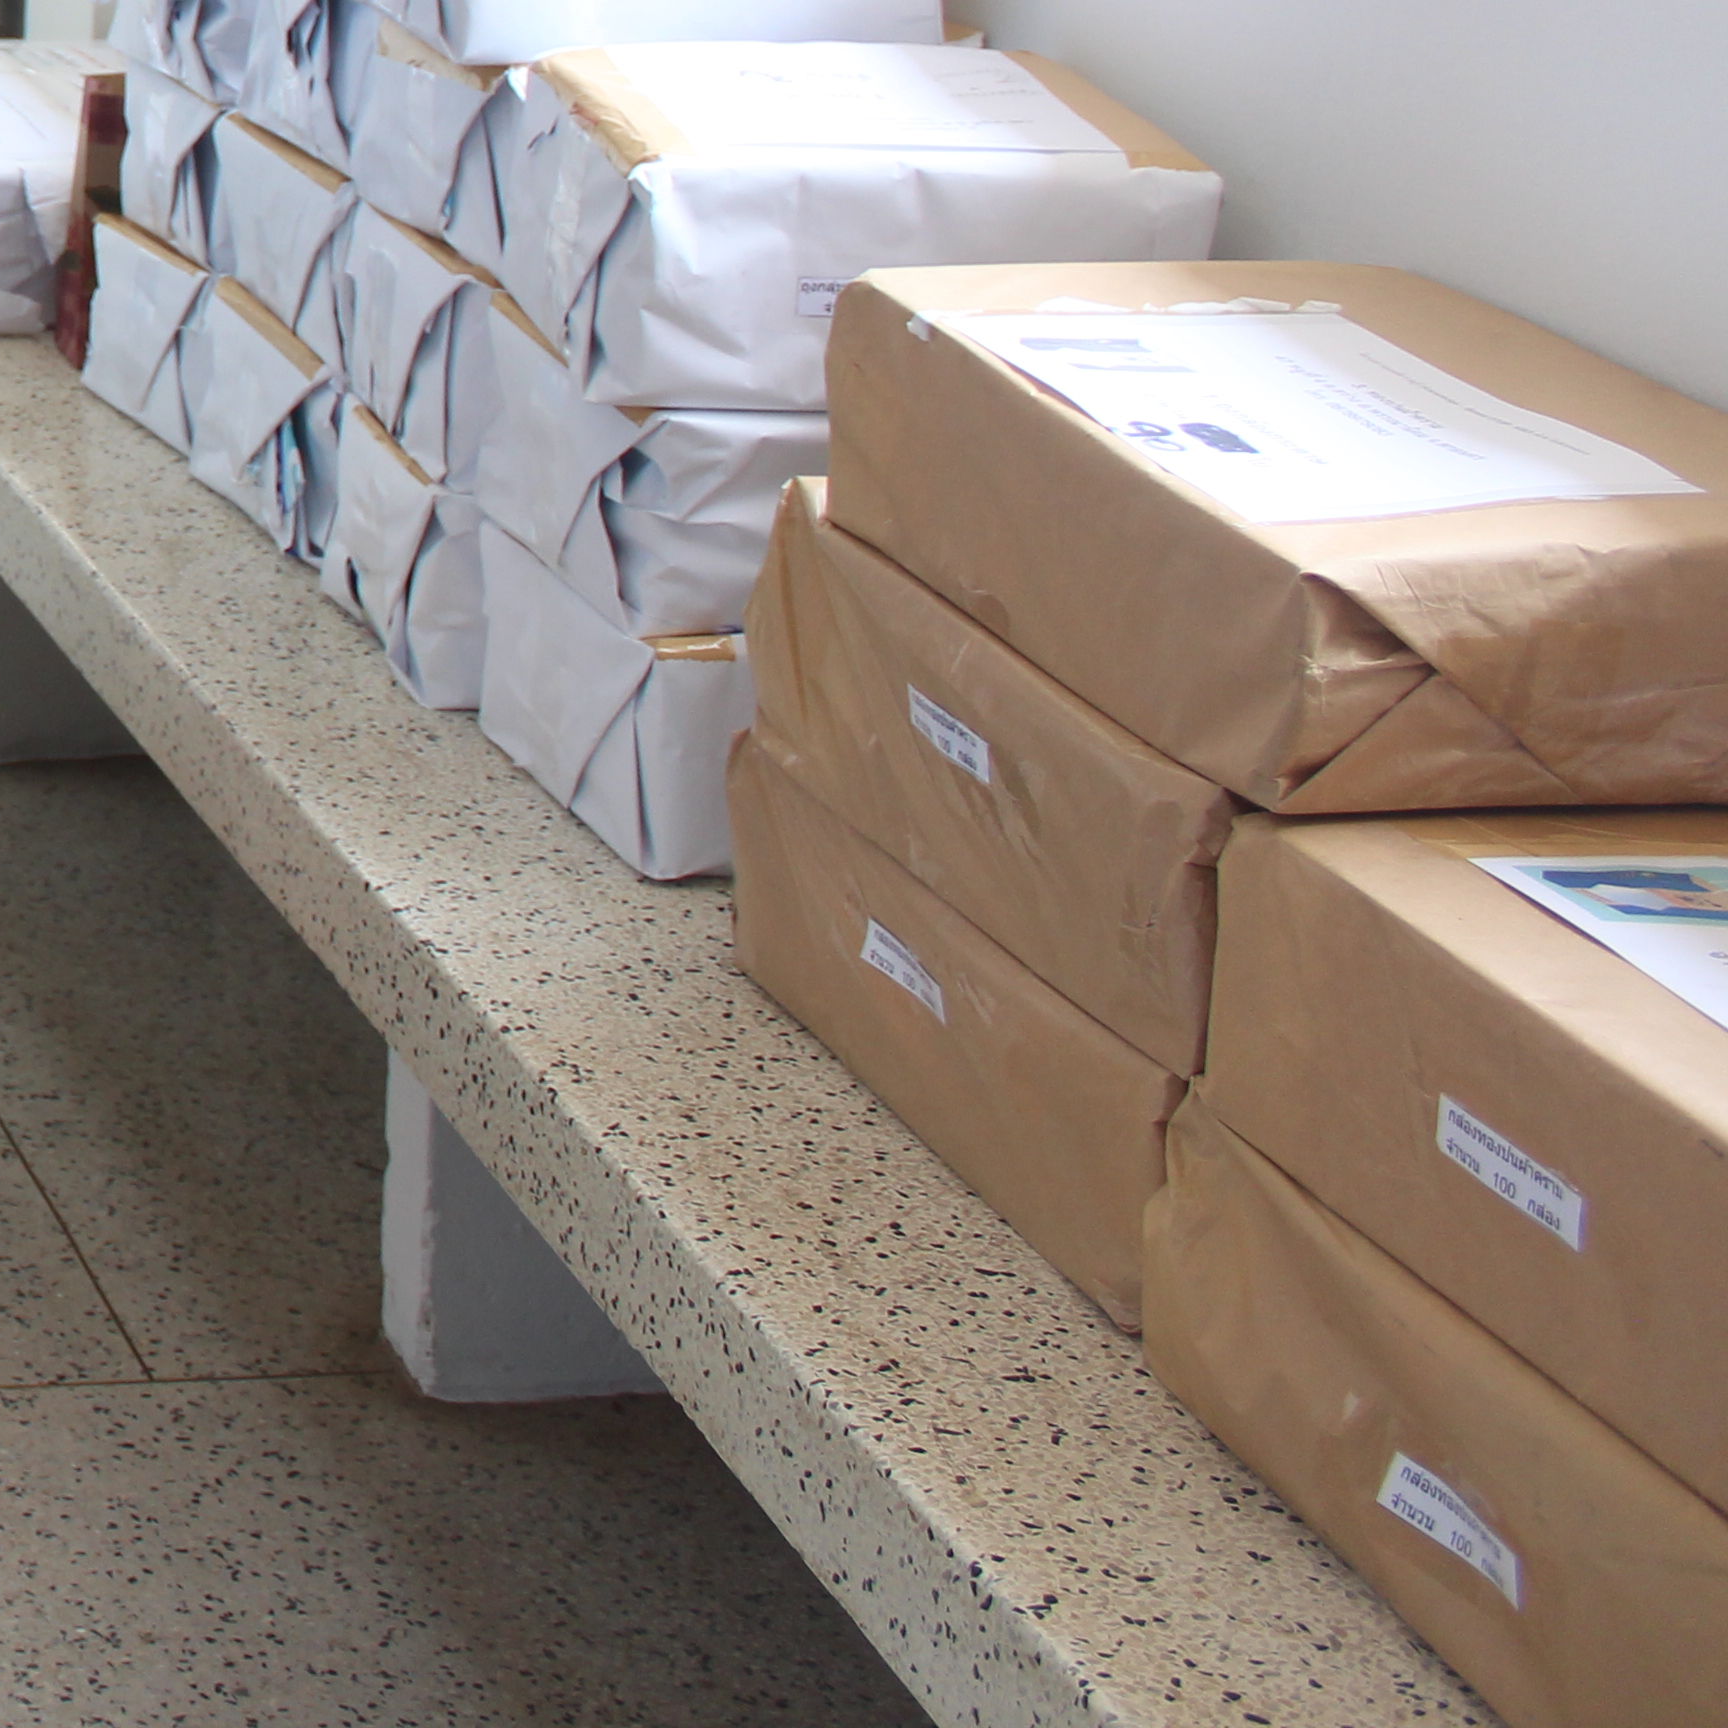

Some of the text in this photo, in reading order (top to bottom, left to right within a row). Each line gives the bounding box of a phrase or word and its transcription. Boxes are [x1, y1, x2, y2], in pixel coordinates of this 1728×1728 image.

[1446, 1137, 1561, 1231] จำนวน 100 กล่อง
[1391, 1492, 1436, 1532] จำนวน
[1450, 1530, 1472, 1558] 100
